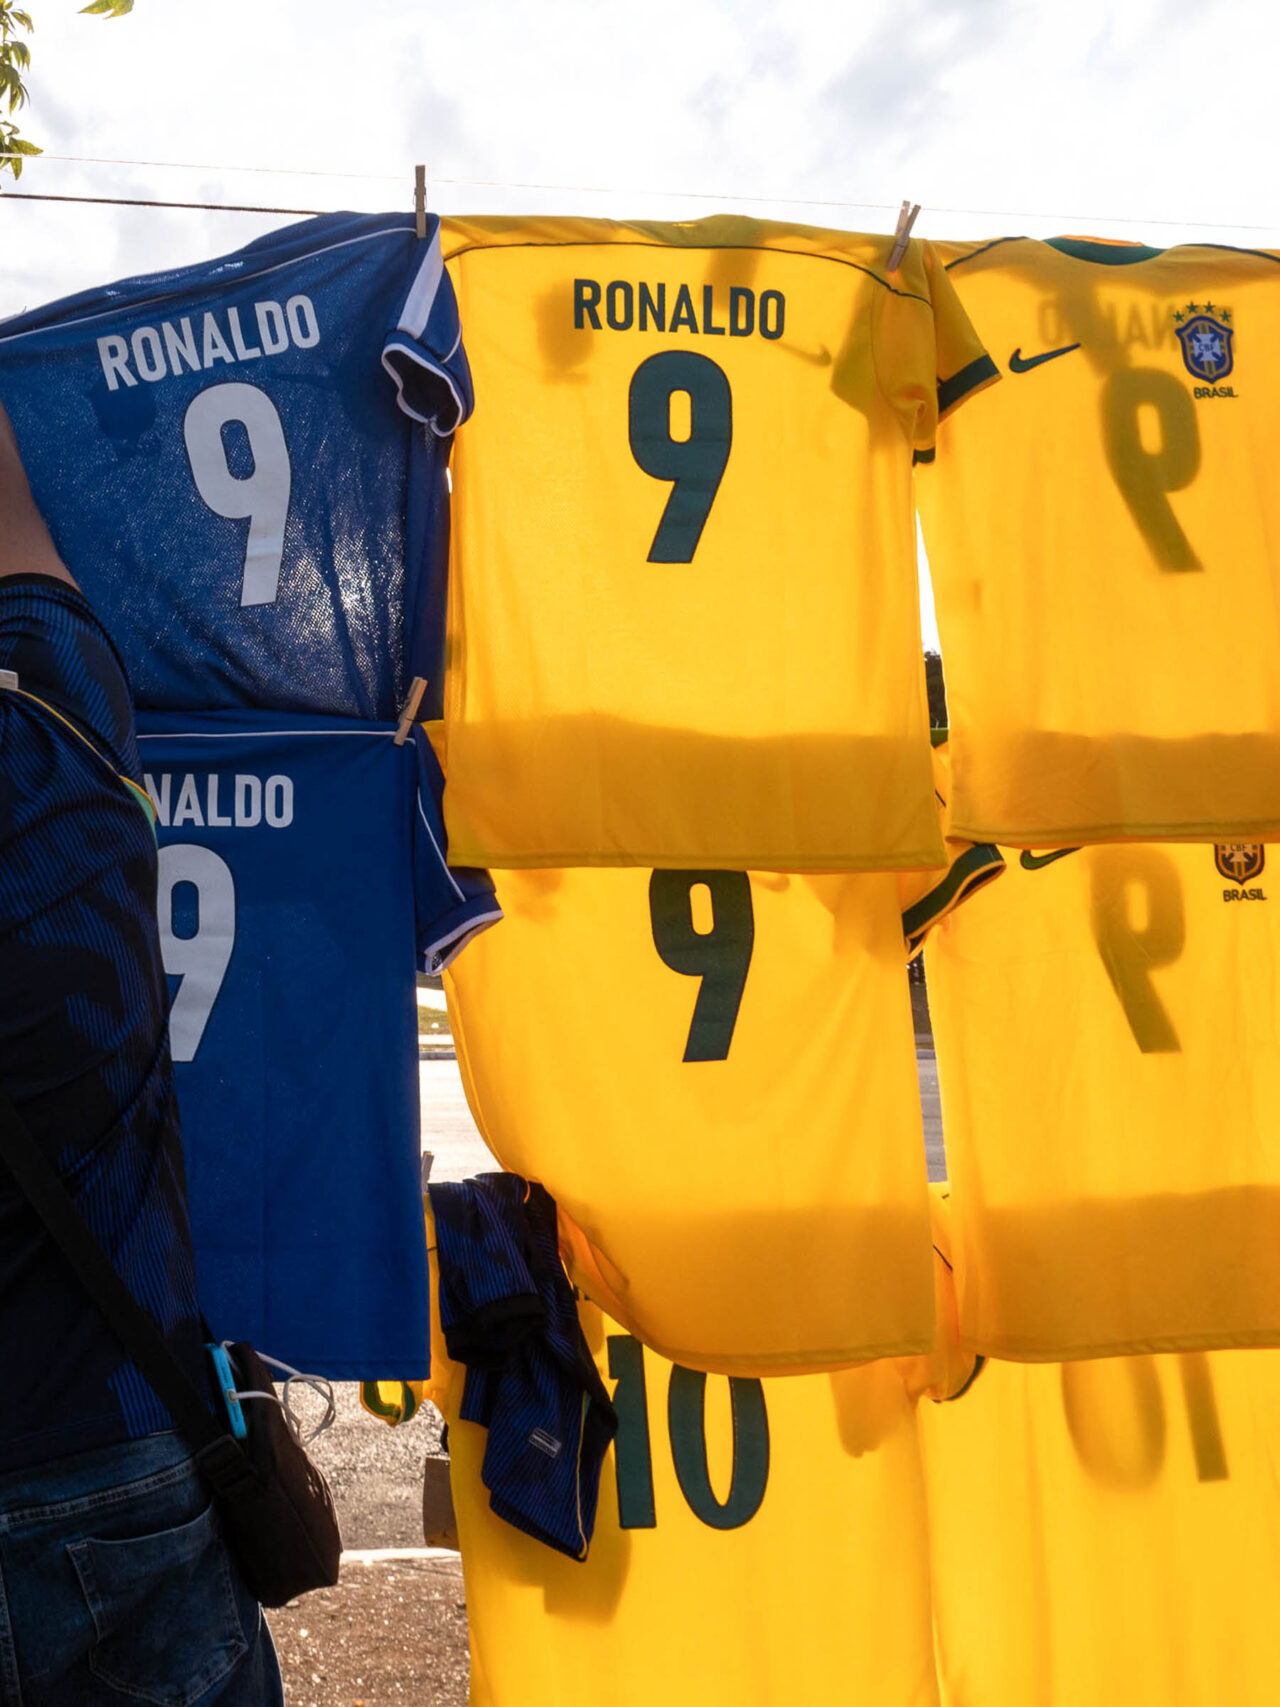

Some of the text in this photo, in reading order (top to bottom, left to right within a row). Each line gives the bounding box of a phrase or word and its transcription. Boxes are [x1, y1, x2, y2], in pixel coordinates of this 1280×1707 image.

[96, 295, 320, 391] RONALDO
[573, 278, 786, 340] RONALDO
[1193, 387, 1239, 399] BRASIL
[183, 382, 291, 607] 9
[628, 350, 733, 564] 9
[157, 843, 235, 1062] 9
[649, 868, 755, 1062] 9
[1223, 888, 1268, 902] BRASIL
[607, 1335, 770, 1530] 10
